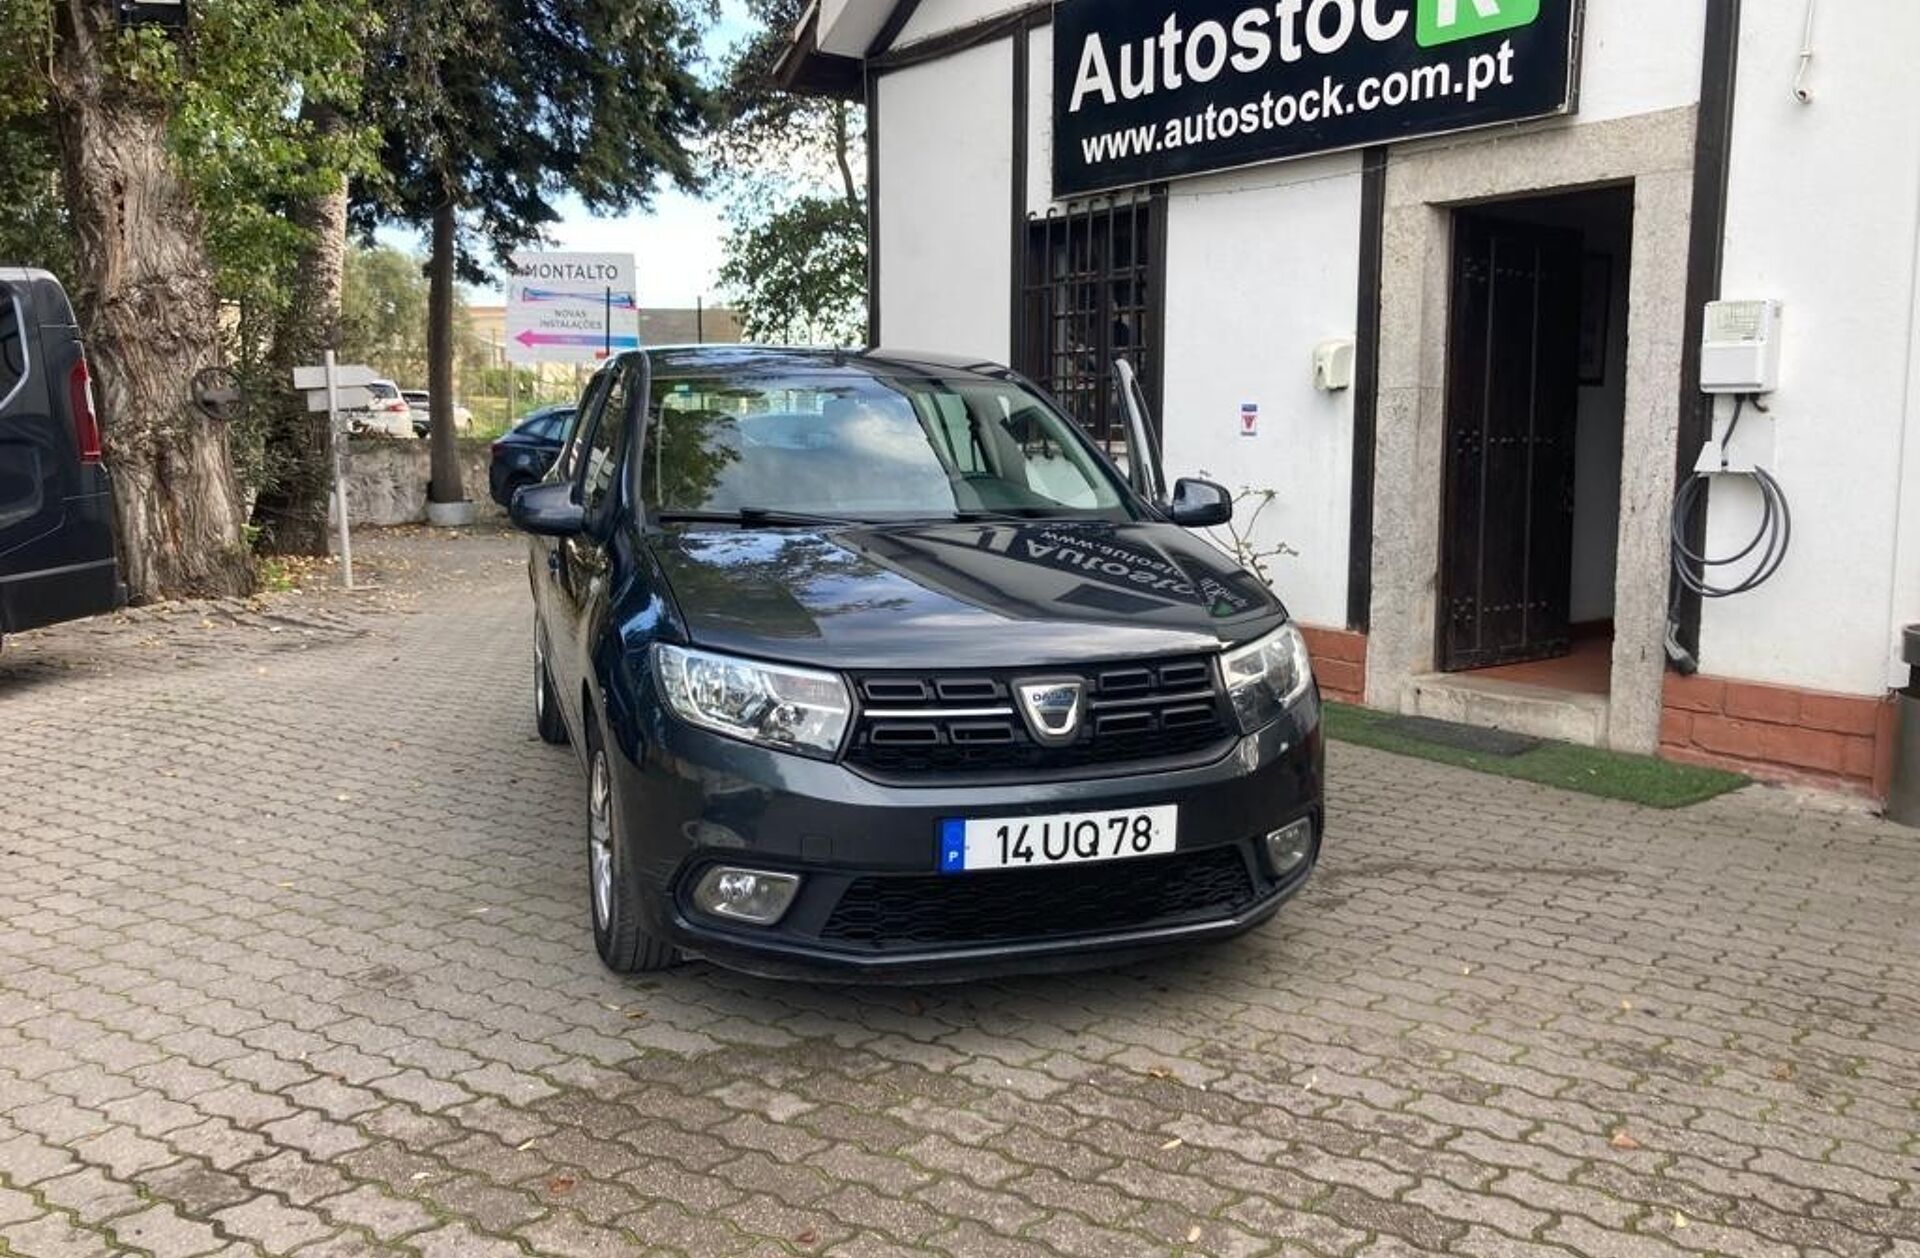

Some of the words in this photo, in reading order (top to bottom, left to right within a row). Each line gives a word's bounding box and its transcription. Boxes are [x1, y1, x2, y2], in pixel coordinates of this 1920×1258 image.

[1081, 39, 1515, 165] www.autostock.com.pt
[526, 263, 618, 280] MONTALTO
[554, 309, 586, 318] NOVAS
[949, 851, 959, 862] P
